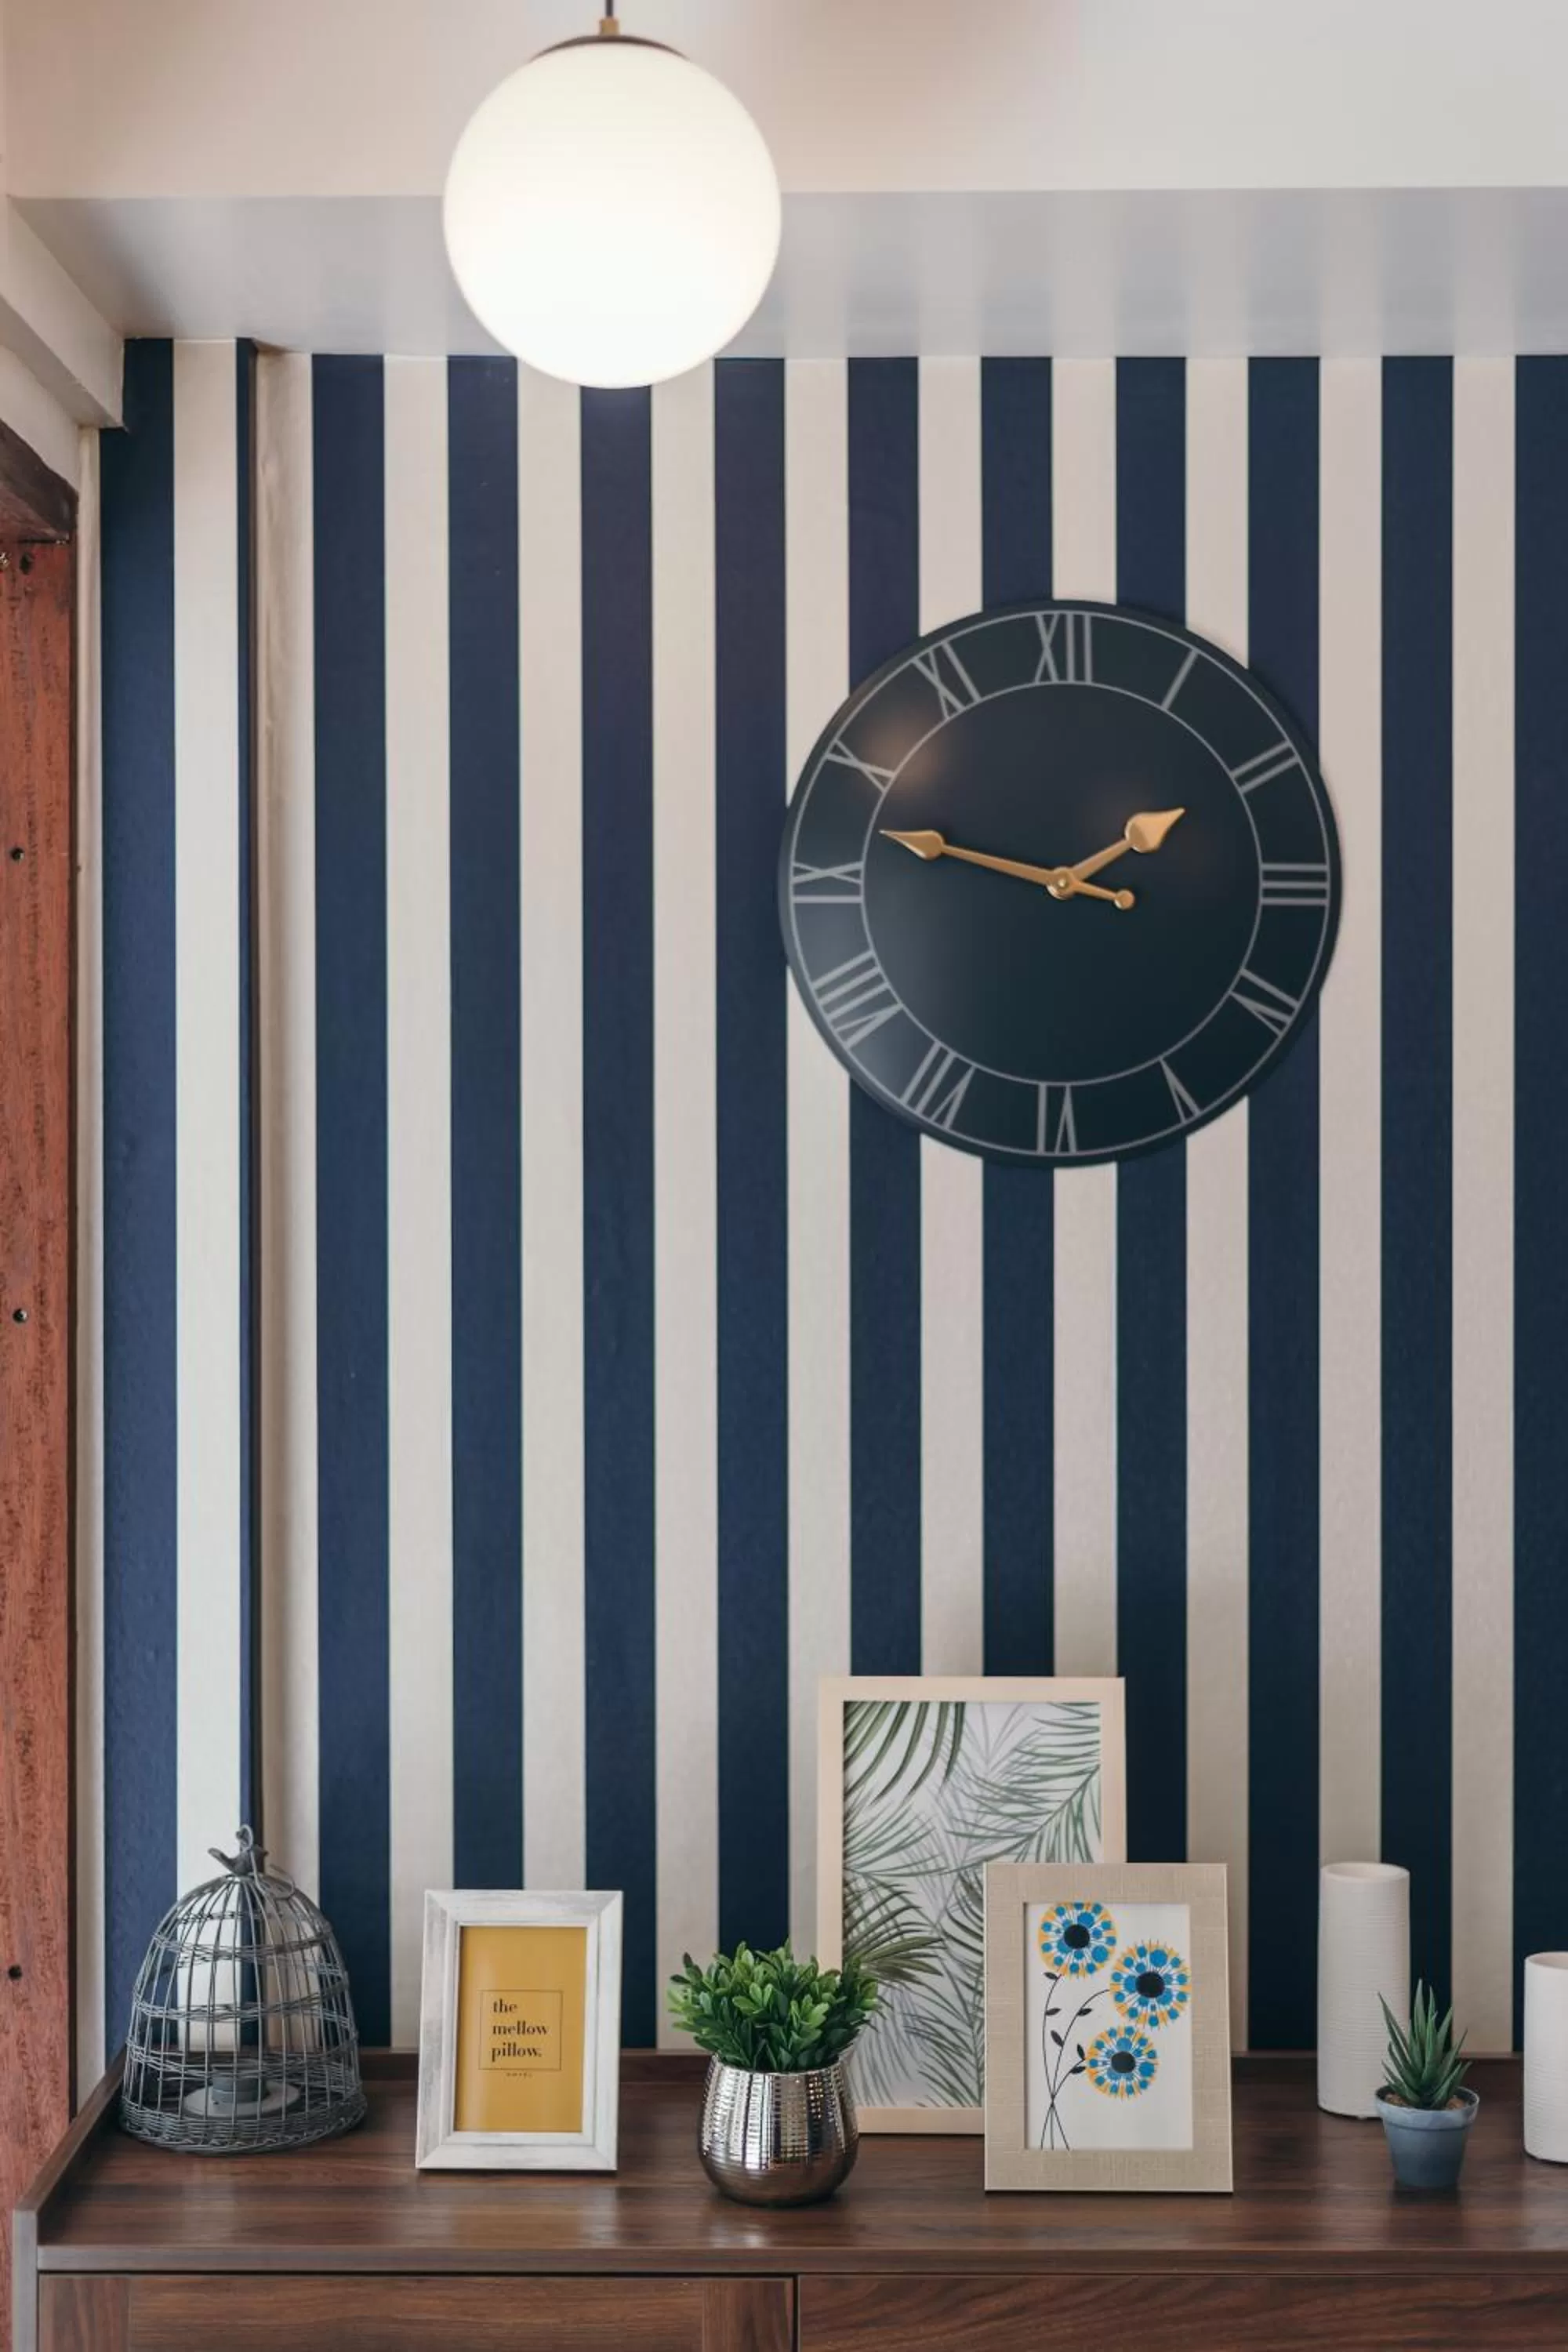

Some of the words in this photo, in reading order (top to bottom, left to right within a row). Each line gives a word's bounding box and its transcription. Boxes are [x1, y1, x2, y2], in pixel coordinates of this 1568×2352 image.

[492, 1998, 517, 2014] the
[492, 2020, 550, 2035] mellow
[492, 2042, 543, 2063] pillow.
